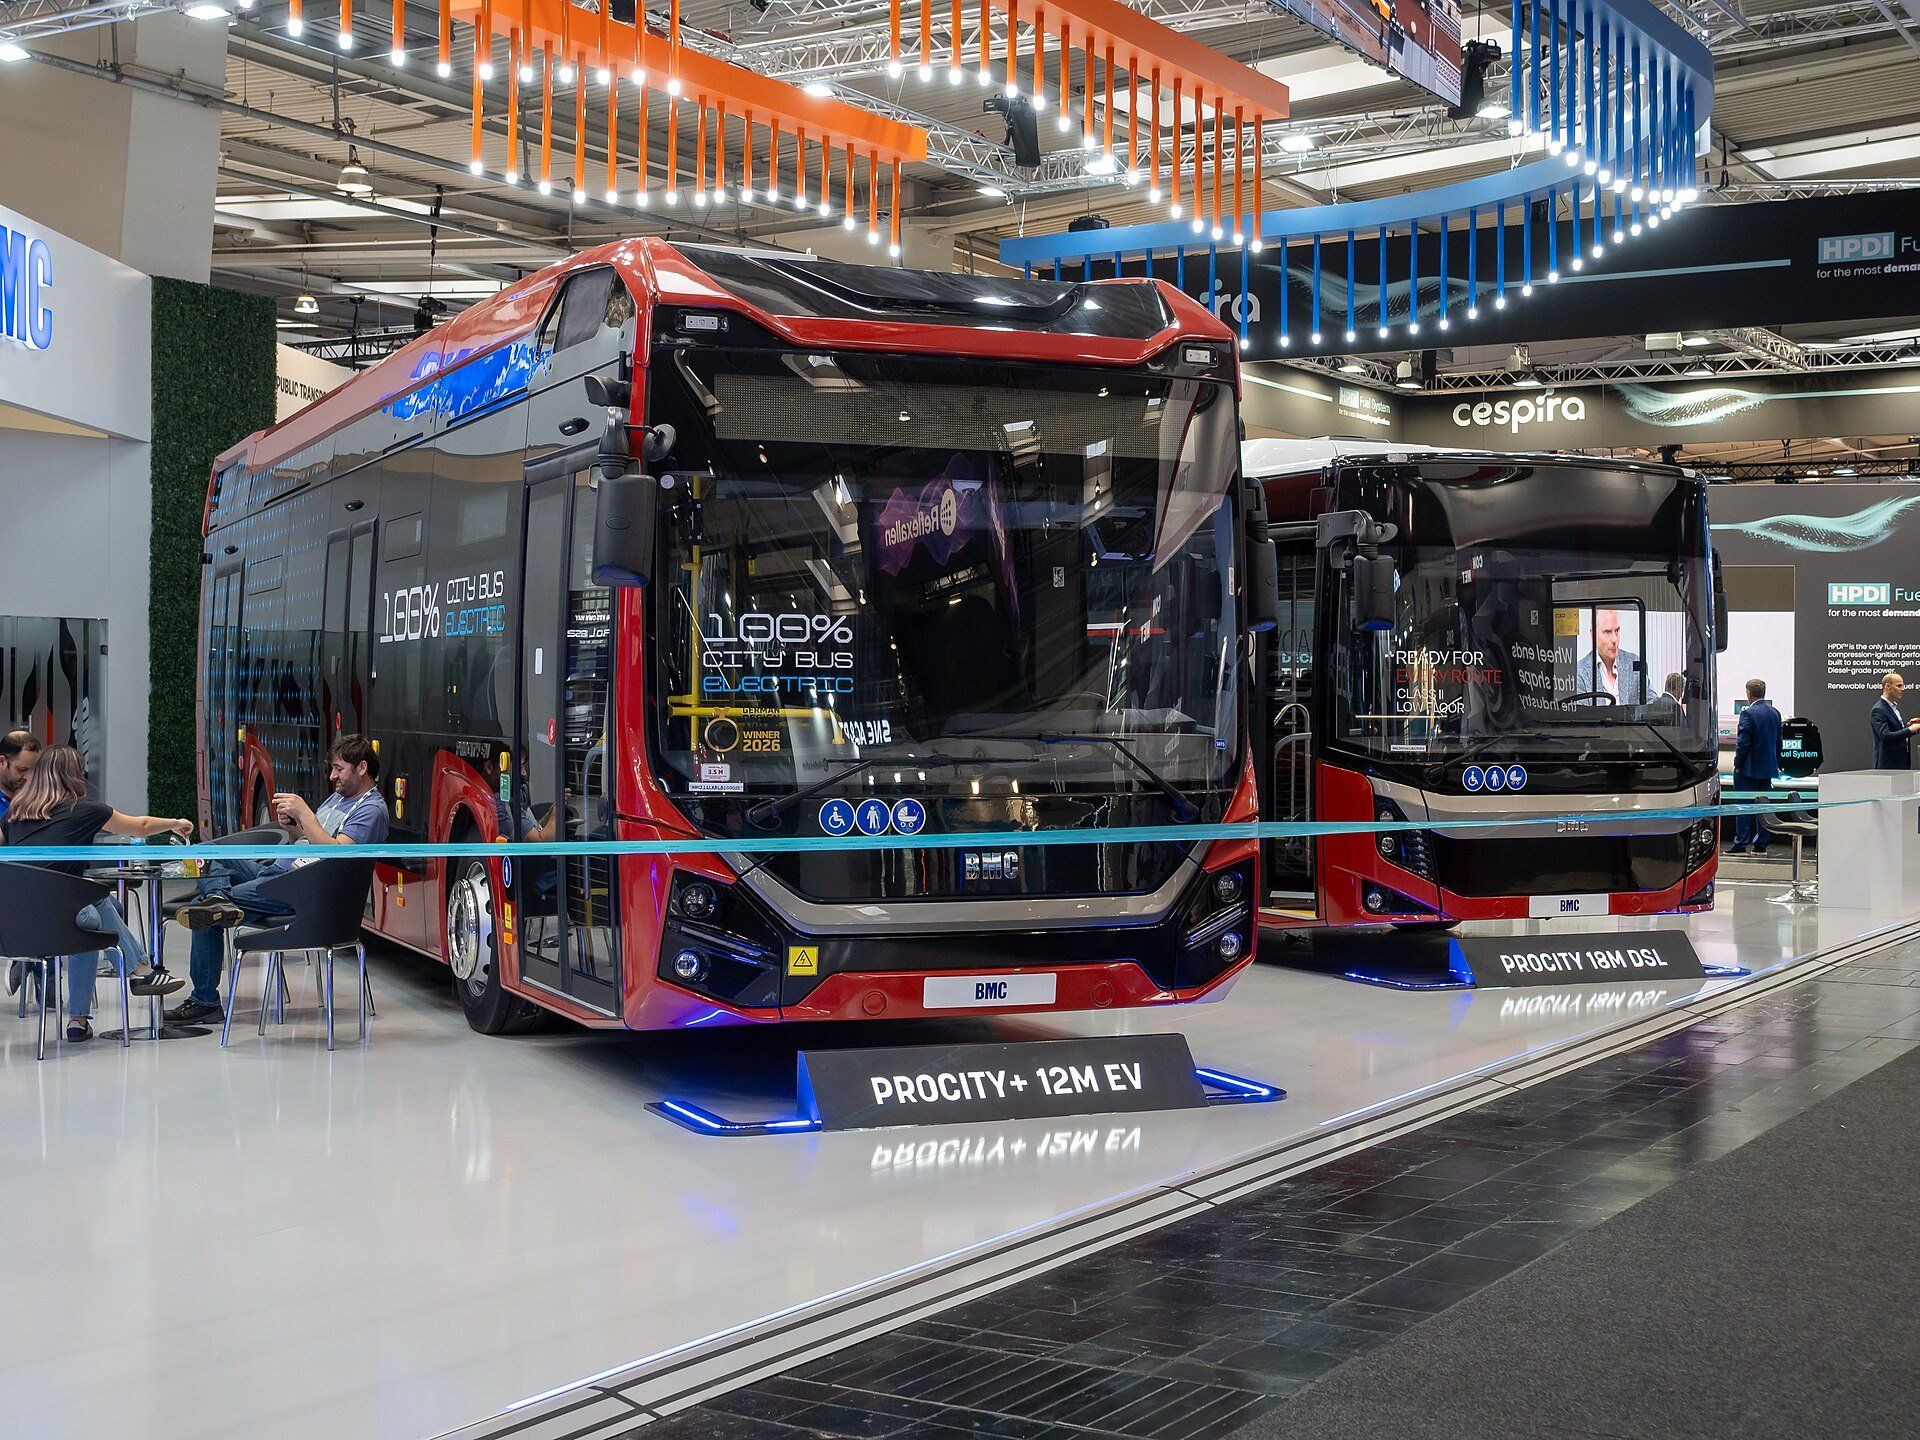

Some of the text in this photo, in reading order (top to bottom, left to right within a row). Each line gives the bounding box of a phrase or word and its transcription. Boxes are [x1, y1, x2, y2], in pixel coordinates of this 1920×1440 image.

[1823, 236, 1890, 260] HPDI
[1817, 269, 1832, 279] for
[1834, 268, 1851, 277] the
[1854, 265, 1881, 276] most
[1453, 389, 1585, 434] cespira
[446, 570, 504, 605] CITY BUS
[1832, 585, 1887, 602] HPDI
[380, 582, 440, 643] 100%
[445, 604, 506, 637] ELECTRIC
[1828, 609, 1841, 617] for
[1842, 609, 1857, 617] the
[1858, 609, 1881, 617] most
[703, 613, 853, 644] 100%
[1868, 643, 1884, 651] only
[702, 651, 854, 668] CITY BUS
[1396, 651, 1484, 666] READY FOR
[1827, 651, 1900, 660] compression-ignition
[1880, 659, 1914, 668] hydrogen
[1396, 668, 1502, 685] EVERY ROUTE
[1827, 667, 1872, 676] Diesel-grade
[703, 676, 854, 693] ELECTRIC
[1827, 682, 1866, 690] Renewable
[1867, 682, 1883, 690] fuels
[1903, 682, 1914, 690] uel
[1397, 688, 1444, 700] CLASS II
[1396, 701, 1465, 714] LOW FLOOR
[742, 730, 780, 739] WINNER
[742, 739, 781, 752] 2026
[1780, 750, 1818, 759] uel System
[964, 851, 1019, 880] BMC
[1560, 899, 1580, 912] BMC
[1500, 948, 1668, 974] PROCITY 18M DSL
[975, 981, 1008, 1000] BMC
[870, 1063, 1142, 1105] PROCITY+ 12M EV
